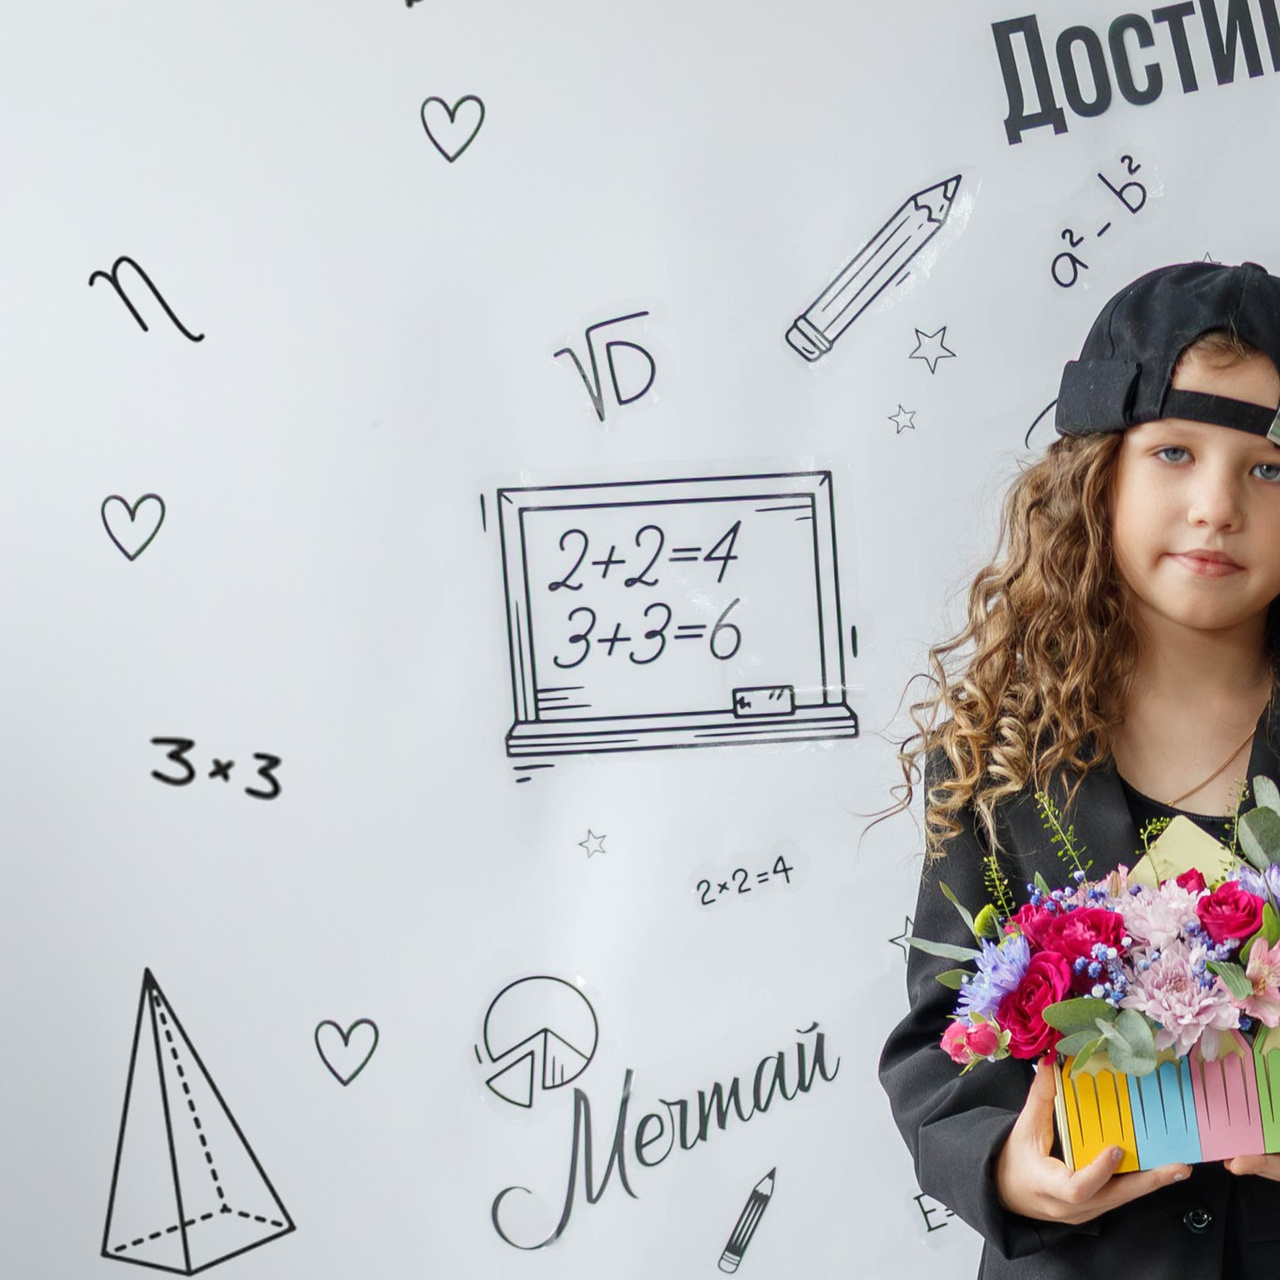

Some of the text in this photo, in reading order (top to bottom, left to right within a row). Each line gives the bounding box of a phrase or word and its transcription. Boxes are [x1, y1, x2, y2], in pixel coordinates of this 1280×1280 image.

[548, 520, 742, 593] 2+2=4
[553, 598, 742, 670] 3+3=6
[491, 1021, 841, 1250] Мечтай
